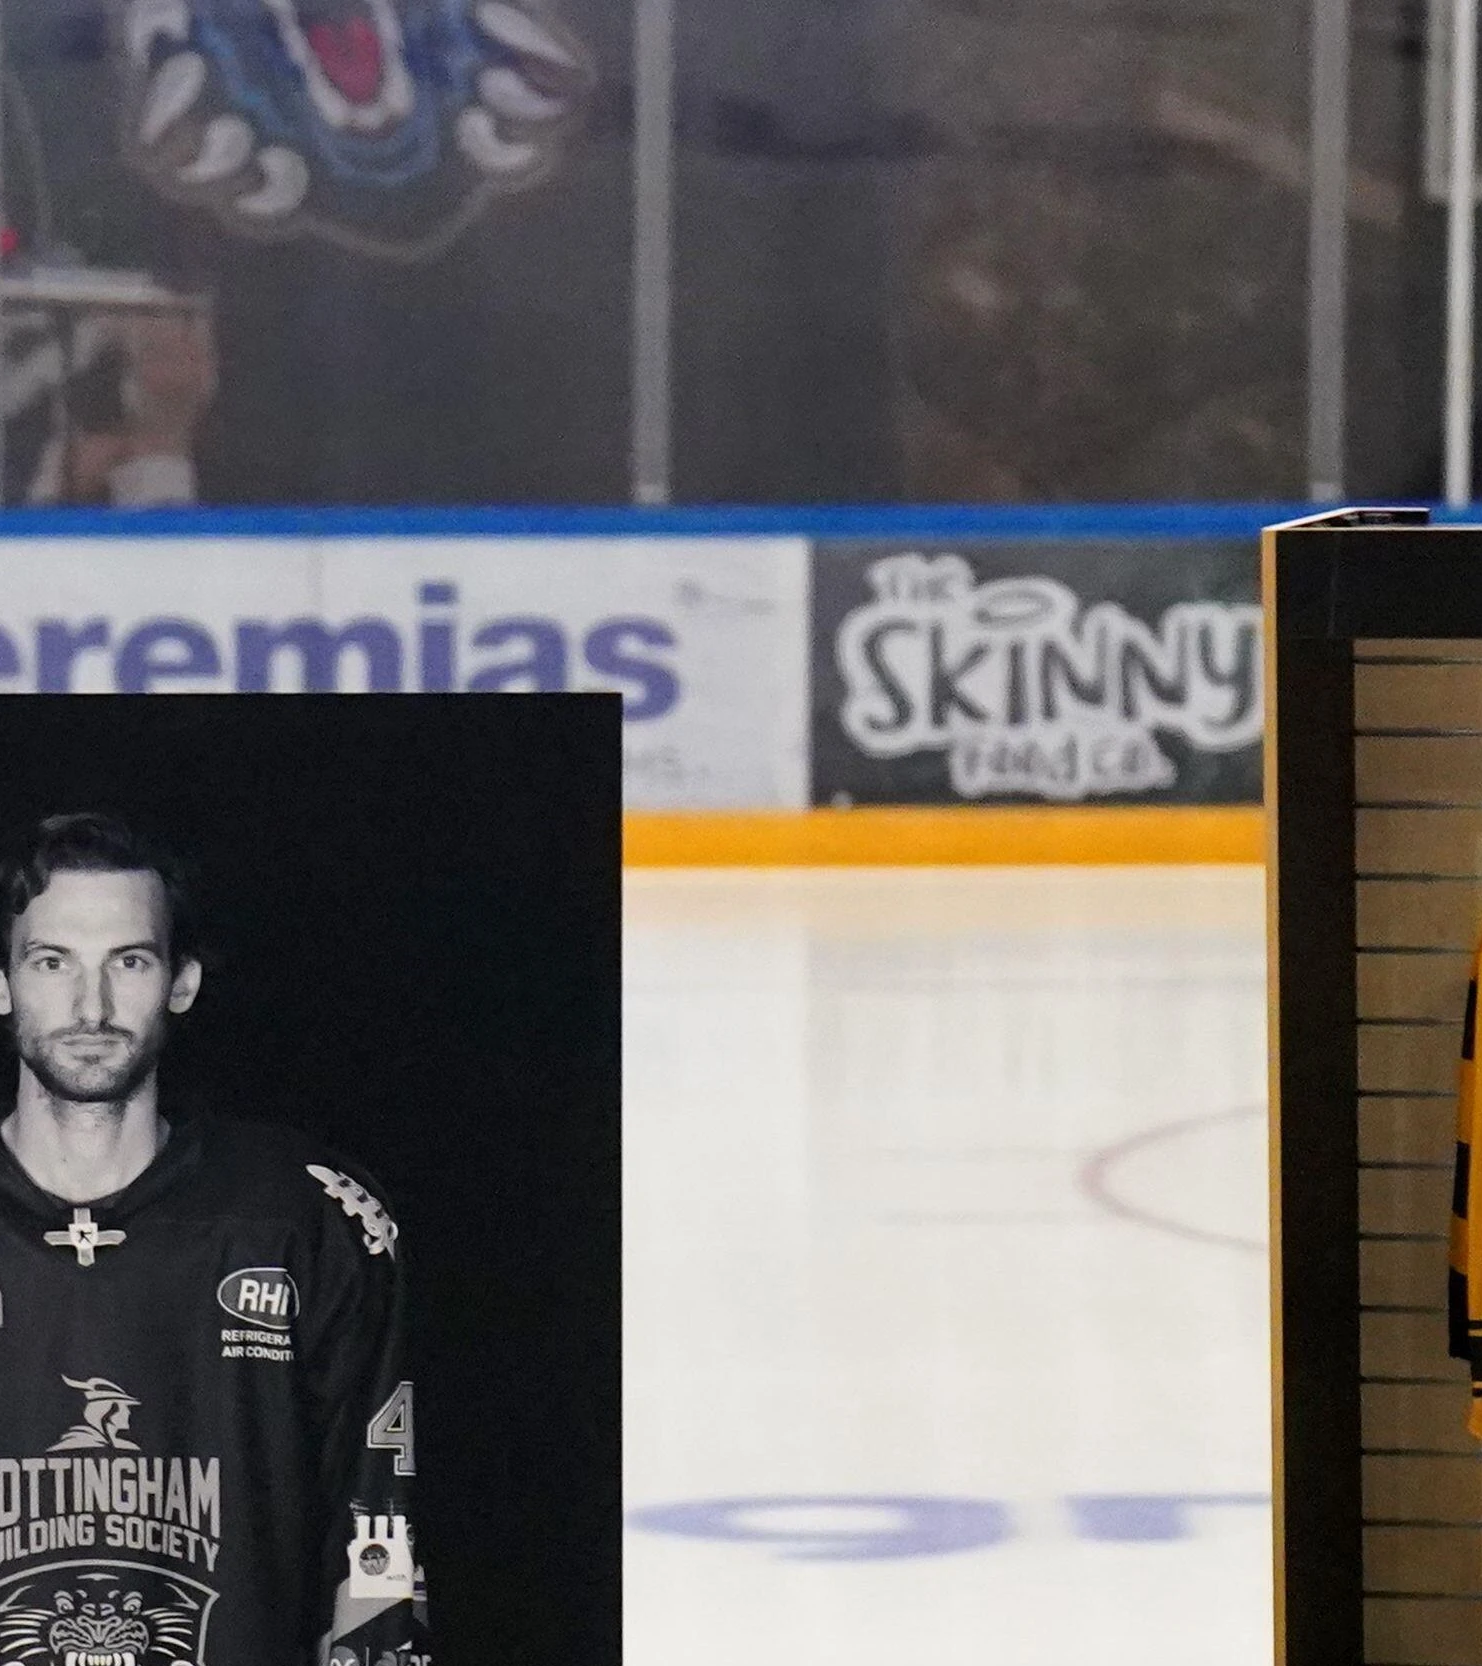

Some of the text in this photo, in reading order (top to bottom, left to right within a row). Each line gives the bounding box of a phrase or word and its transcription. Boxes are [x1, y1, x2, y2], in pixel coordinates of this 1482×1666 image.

[861, 610, 1260, 734] SKINNY
[238, 1278, 291, 1317] RHI
[221, 1345, 244, 1358] AIR
[366, 1380, 416, 1477] 4
[104, 1513, 221, 1573] SOCIETY
